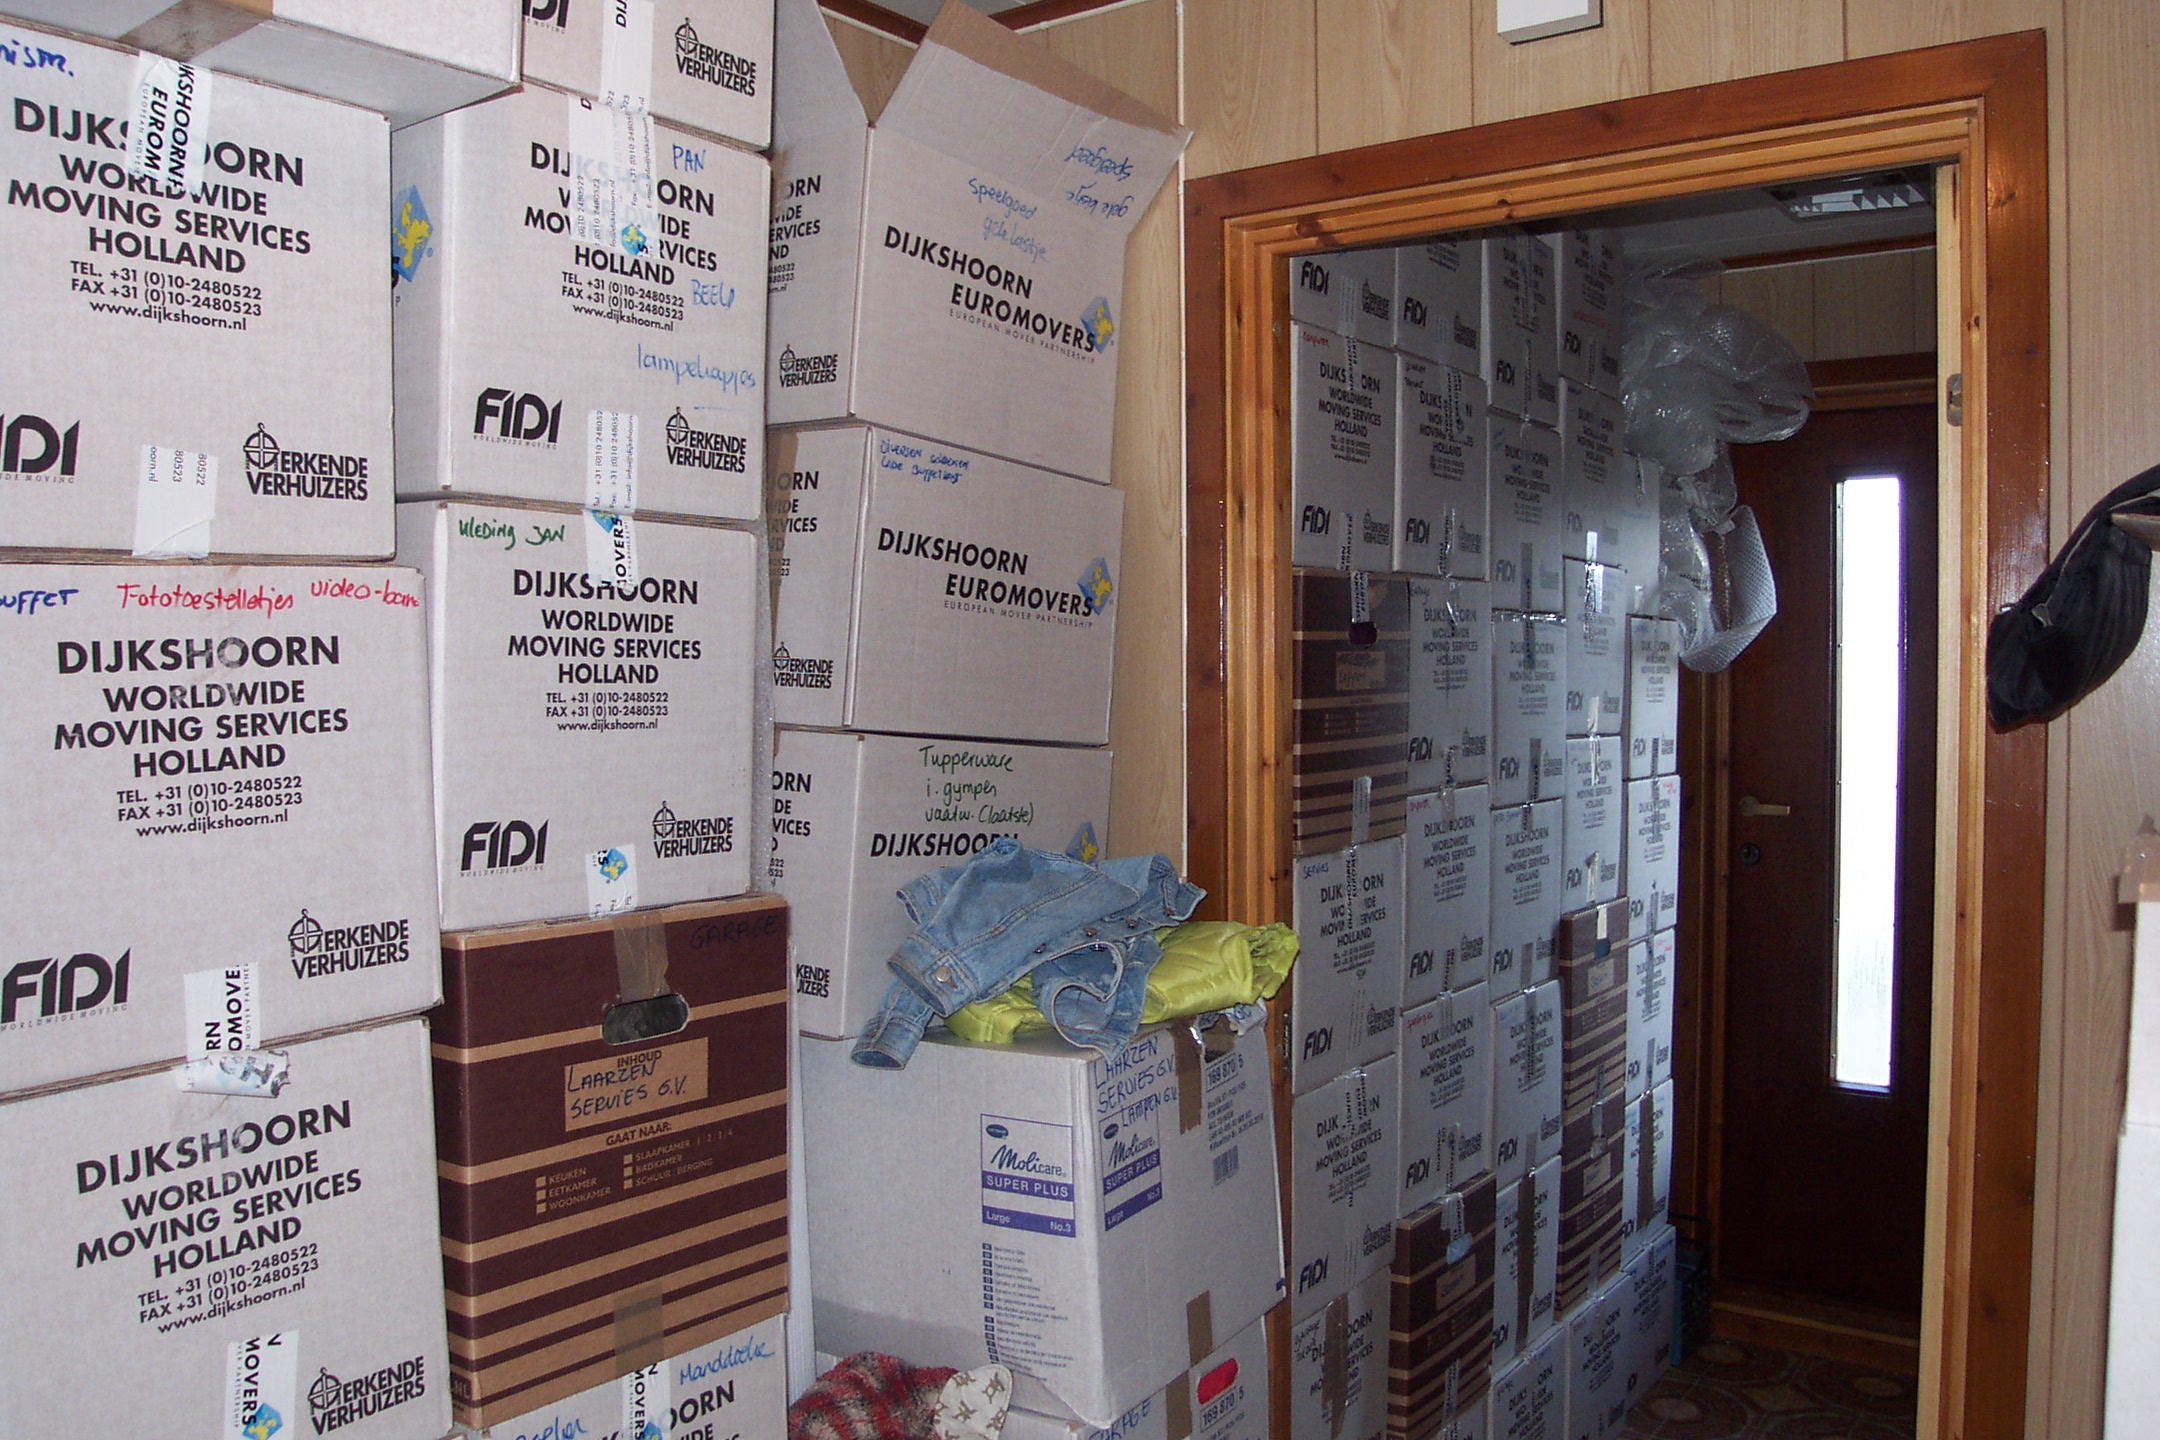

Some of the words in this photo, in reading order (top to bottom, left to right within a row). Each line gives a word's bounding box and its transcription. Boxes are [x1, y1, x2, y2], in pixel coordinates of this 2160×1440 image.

[675, 54, 756, 97] VERHUIZERS
[699, 43, 757, 79] ERKENDE
[13, 97, 304, 187] DIJKORN
[9, 180, 162, 229] MOVING
[175, 209, 311, 255] SERVICES
[89, 227, 246, 274] HOLLAND
[574, 244, 675, 286] HOLLAND
[884, 225, 1033, 299] DIJKSHOORN
[71, 260, 103, 277] TEL.
[110, 268, 138, 282] +31
[144, 271, 262, 300] (0)10-2480522
[561, 271, 583, 286] TEL.
[609, 281, 685, 308] (0)10-2480522
[1301, 261, 1329, 296] FIDI
[71, 278, 105, 296] FAX
[110, 285, 138, 300] +31
[144, 287, 262, 317] (0)10-2480523
[561, 285, 583, 300] FAX
[609, 295, 684, 321] (0)10-2480523
[89, 300, 247, 331] www.dijkshoorn.nl
[573, 303, 674, 332] www.dijkshoorn.nl
[949, 309, 1000, 332] EUROPEAN
[1005, 329, 1036, 345] MOVER
[951, 283, 1095, 353] EUROMOVERS
[779, 369, 837, 388] VERHUIZERS
[795, 354, 838, 371] ERKENDE
[473, 387, 563, 444] FIDI
[667, 446, 746, 473] VERHUIZERS
[690, 430, 747, 455] ERKENDE
[281, 451, 368, 479] ERKENDE
[247, 472, 369, 501] VERHUIZERS
[1302, 505, 1331, 535] FIDI
[1405, 518, 1430, 544] FIDI
[878, 527, 1028, 575] DIJKSHOORN
[944, 601, 995, 615] EUROPEAN
[1000, 609, 1031, 621] MOVER
[945, 573, 1093, 617] EUROMOVERS
[541, 609, 674, 633] WORLDWIDE
[57, 635, 340, 674] DIJKSHOORN
[507, 635, 606, 658] MOVING
[613, 637, 702, 660] SERVICES
[558, 663, 659, 684] HOLLAND
[773, 672, 832, 689] VERHUIZERS
[789, 658, 834, 675] ERKENDE
[103, 680, 305, 713] WORLDWIDE
[546, 692, 567, 703] TEL.
[592, 692, 669, 706] (0)10-2480522
[546, 706, 567, 718] FAX
[571, 706, 588, 718] +31
[592, 705, 669, 720] (0)10-2480523
[54, 716, 202, 751] MOVING
[216, 708, 349, 740] SERVICES
[557, 718, 658, 733] www.dijkshoorn.nl
[133, 743, 286, 778] HOLLAND
[919, 745, 1014, 774] Tupperware
[1408, 737, 1433, 763] FIDI
[117, 790, 148, 805] TEL.
[154, 786, 182, 801] +31
[187, 775, 303, 799] (0)10-2480522
[117, 806, 151, 822] FAX
[156, 803, 183, 818] +31
[189, 792, 303, 817] (0)10-2480523
[136, 809, 288, 837] www.dijkshoorn.nl
[676, 817, 733, 838] ERKENDE
[461, 819, 549, 871] FIDI
[654, 836, 733, 859] VERHUIZERS
[324, 919, 409, 953] ERKENDE
[690, 915, 779, 950] GARAGE
[291, 940, 410, 980] VERHUIZERS
[1409, 950, 1434, 979] FIDI
[0, 946, 132, 1024] FIDI
[617, 1050, 662, 1068] INHOUD
[1304, 1026, 1334, 1060] FIDI
[568, 1060, 657, 1092] LAARZEN
[76, 1100, 352, 1194] DIJKSHOORN
[606, 1129, 637, 1146] GAAT
[1109, 1133, 1156, 1168] Molicare
[991, 1144, 1063, 1177] Molicare
[1105, 1165, 1140, 1189] SUPER
[1142, 1153, 1158, 1174] PLUS
[1406, 1158, 1431, 1188] FIDI
[122, 1150, 320, 1221] WORLDWIDE
[986, 1174, 1030, 1192] SUPER
[1034, 1181, 1069, 1198] PLUS
[75, 1207, 221, 1268] MOVING
[233, 1169, 362, 1225] SERVICES
[986, 1210, 1011, 1223] Large
[153, 1216, 302, 1278] HOLLAND
[138, 1292, 169, 1308] TEL.
[175, 1278, 201, 1296] +31
[207, 1243, 319, 1289] (0)10-2480522
[139, 1303, 172, 1324] FAX
[176, 1294, 203, 1312] +31
[208, 1259, 320, 1304] (0)10-2480523
[1299, 1255, 1329, 1295] FIDI
[157, 1278, 306, 1334] www.dijkshoorn.nl
[340, 1356, 425, 1407] ERKENDE
[311, 1375, 426, 1436] VERHUIZERS
[1202, 1405, 1218, 1426] 169
